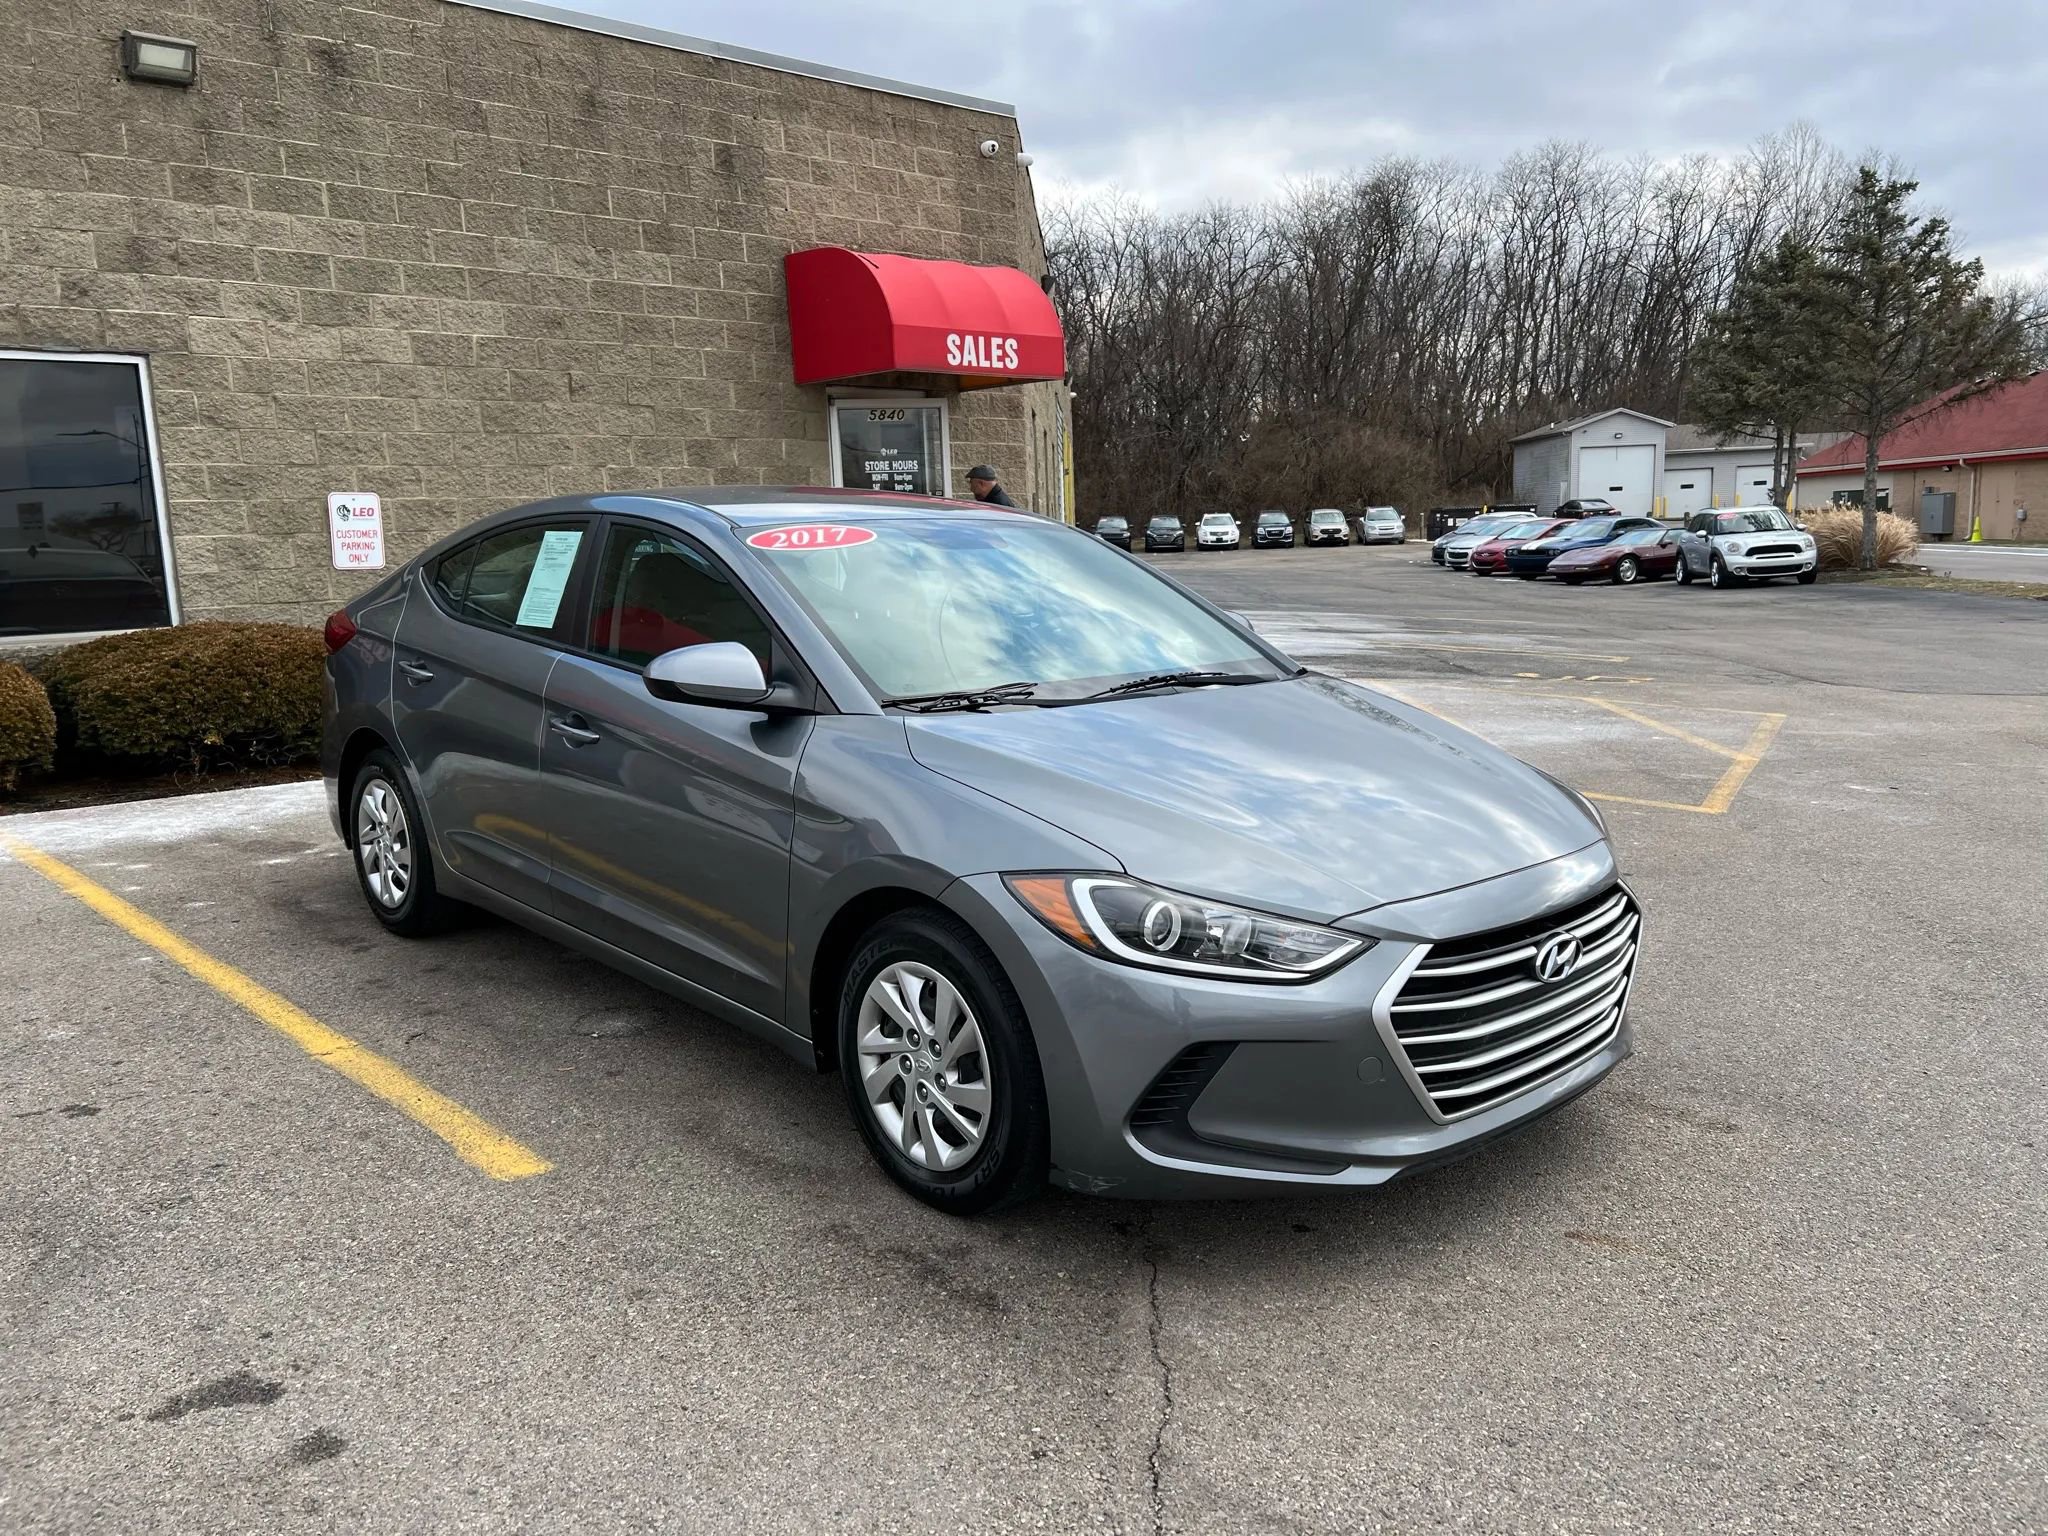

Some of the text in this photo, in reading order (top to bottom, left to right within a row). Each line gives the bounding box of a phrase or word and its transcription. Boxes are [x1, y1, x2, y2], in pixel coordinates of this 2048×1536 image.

[946, 333, 1019, 370] SALES
[869, 409, 905, 421] 5840
[864, 460, 919, 471] STORE HOURS
[352, 507, 375, 517] LEO
[336, 530, 378, 539] CUSTOMER
[770, 527, 848, 548] 2017
[341, 541, 376, 551] PARKING
[634, 544, 654, 553] ARKING
[348, 554, 369, 563] ONLY
